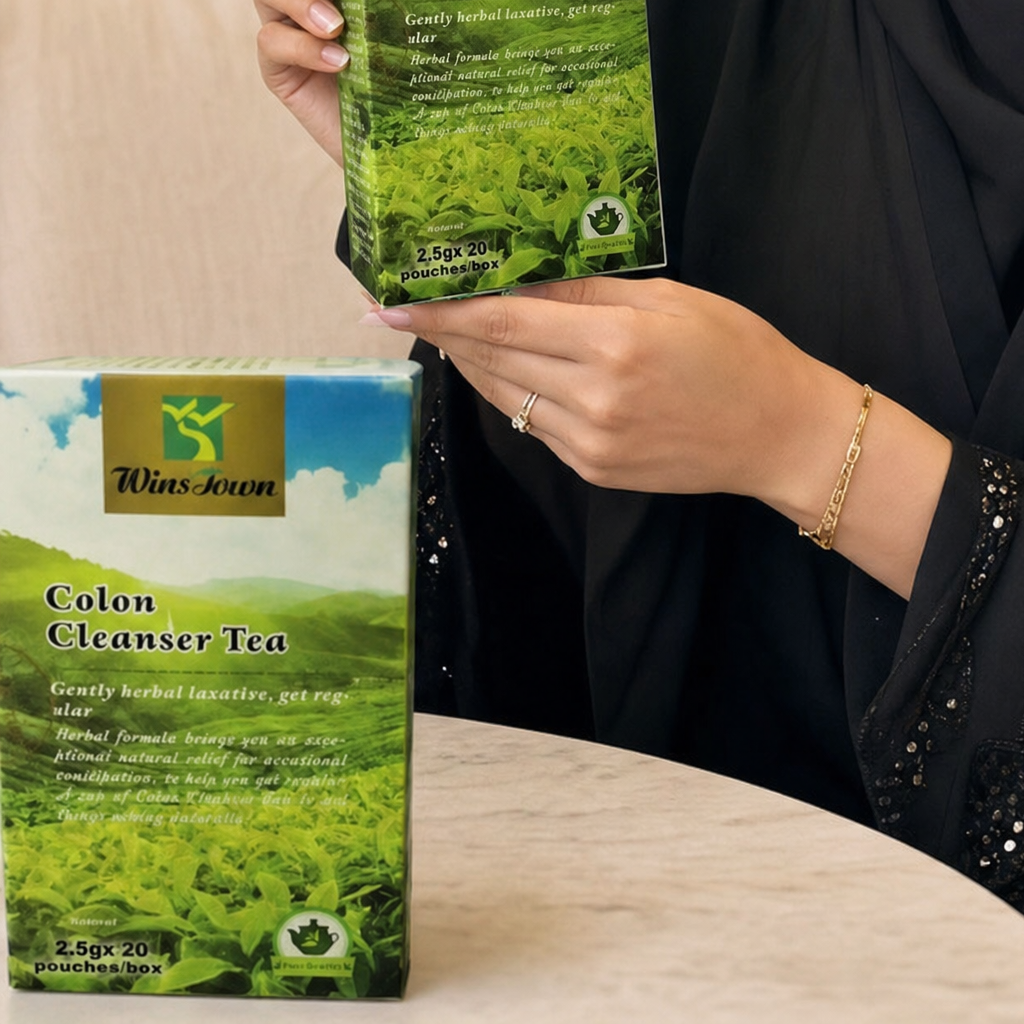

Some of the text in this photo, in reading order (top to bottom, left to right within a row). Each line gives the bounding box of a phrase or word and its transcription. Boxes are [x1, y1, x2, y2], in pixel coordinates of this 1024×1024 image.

[405, 13, 453, 27] Gently
[457, 8, 501, 23] herbal
[568, 3, 588, 18] get
[408, 32, 437, 44] ular
[410, 52, 450, 65] Herbal
[457, 67, 501, 81] natural
[539, 63, 558, 77] for
[416, 241, 487, 263] 2.5gx 20
[400, 259, 500, 283] pouches/box
[45, 584, 157, 614] Colon
[46, 621, 288, 654] Cleanser Tea
[50, 681, 116, 702] Gently
[120, 683, 183, 700] herbal
[277, 688, 308, 705] get
[52, 703, 93, 718] ular
[55, 727, 110, 742] Herbal
[118, 752, 179, 764] natural
[55, 940, 148, 960] 2.5gx 20
[34, 960, 163, 975] pouches/box
